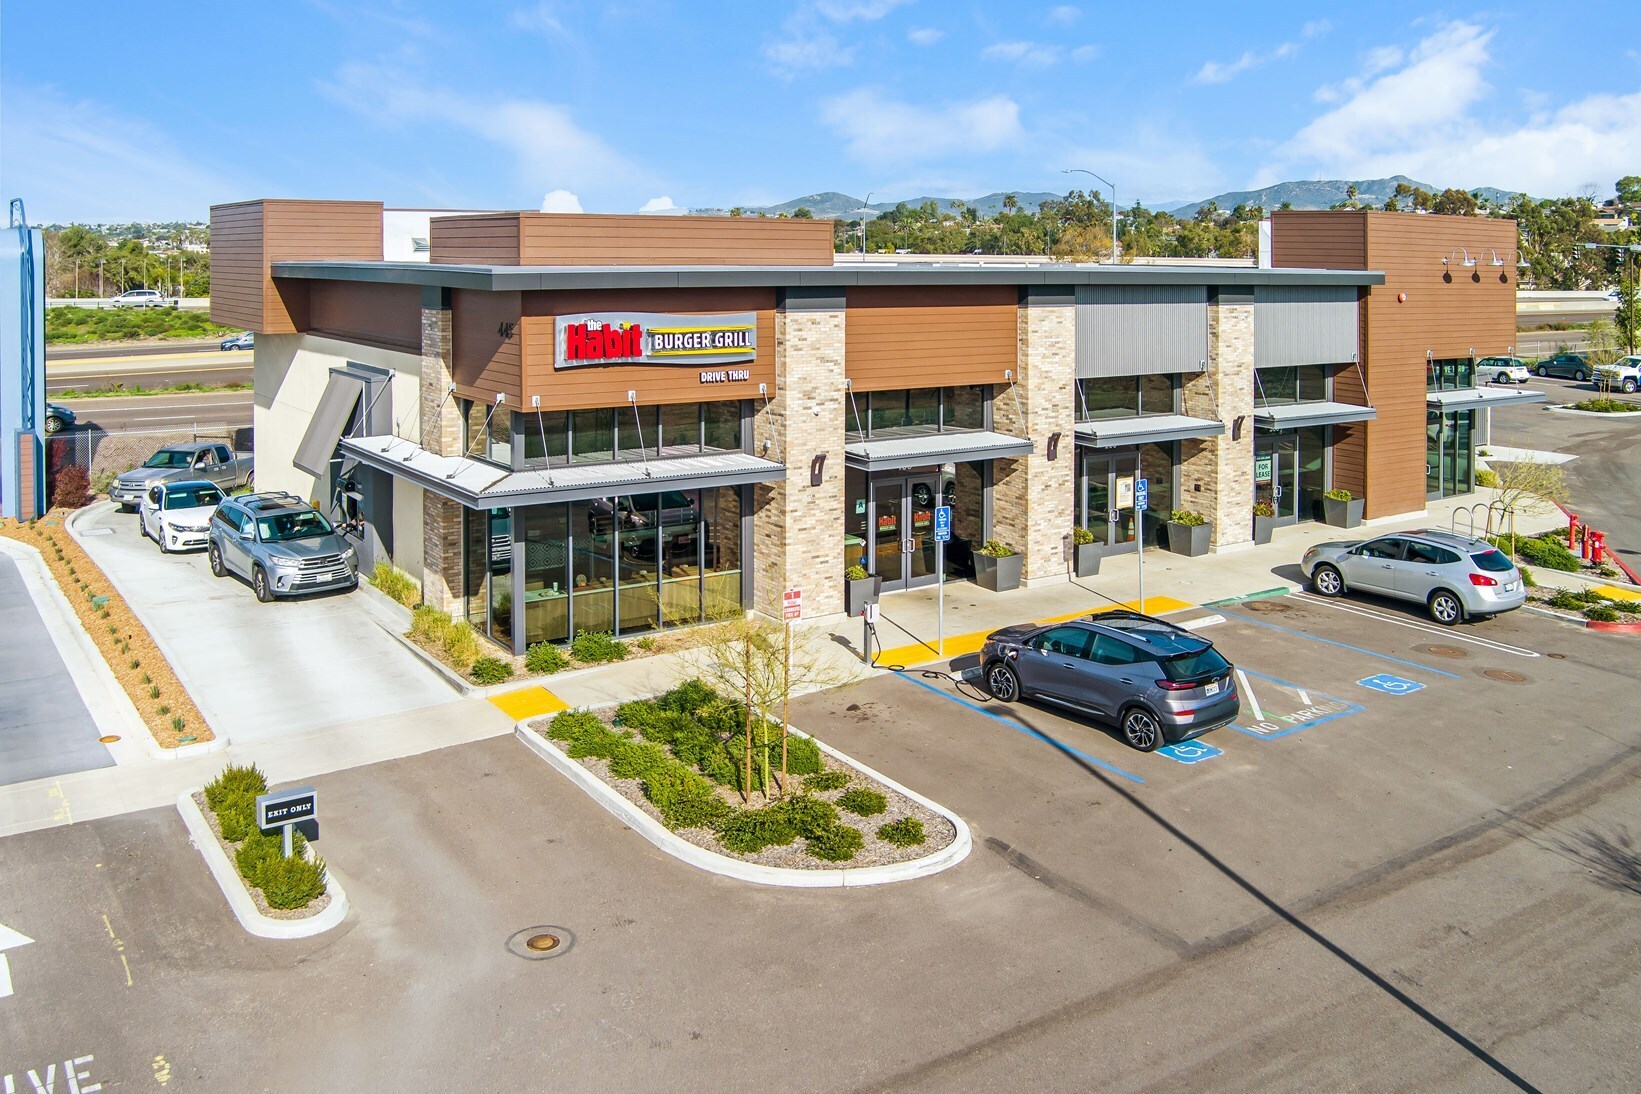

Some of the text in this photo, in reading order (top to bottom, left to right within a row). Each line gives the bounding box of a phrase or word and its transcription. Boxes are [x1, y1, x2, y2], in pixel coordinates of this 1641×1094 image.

[587, 319, 602, 331] the
[567, 321, 643, 360] Habit
[654, 331, 751, 349] BURGER GRILL
[700, 369, 750, 382] DRIVE THRU
[1258, 463, 1269, 471] FOR
[1256, 470, 1271, 479] LEASE
[1246, 722, 1280, 735] NO
[267, 803, 312, 818] EXIT ONLY
